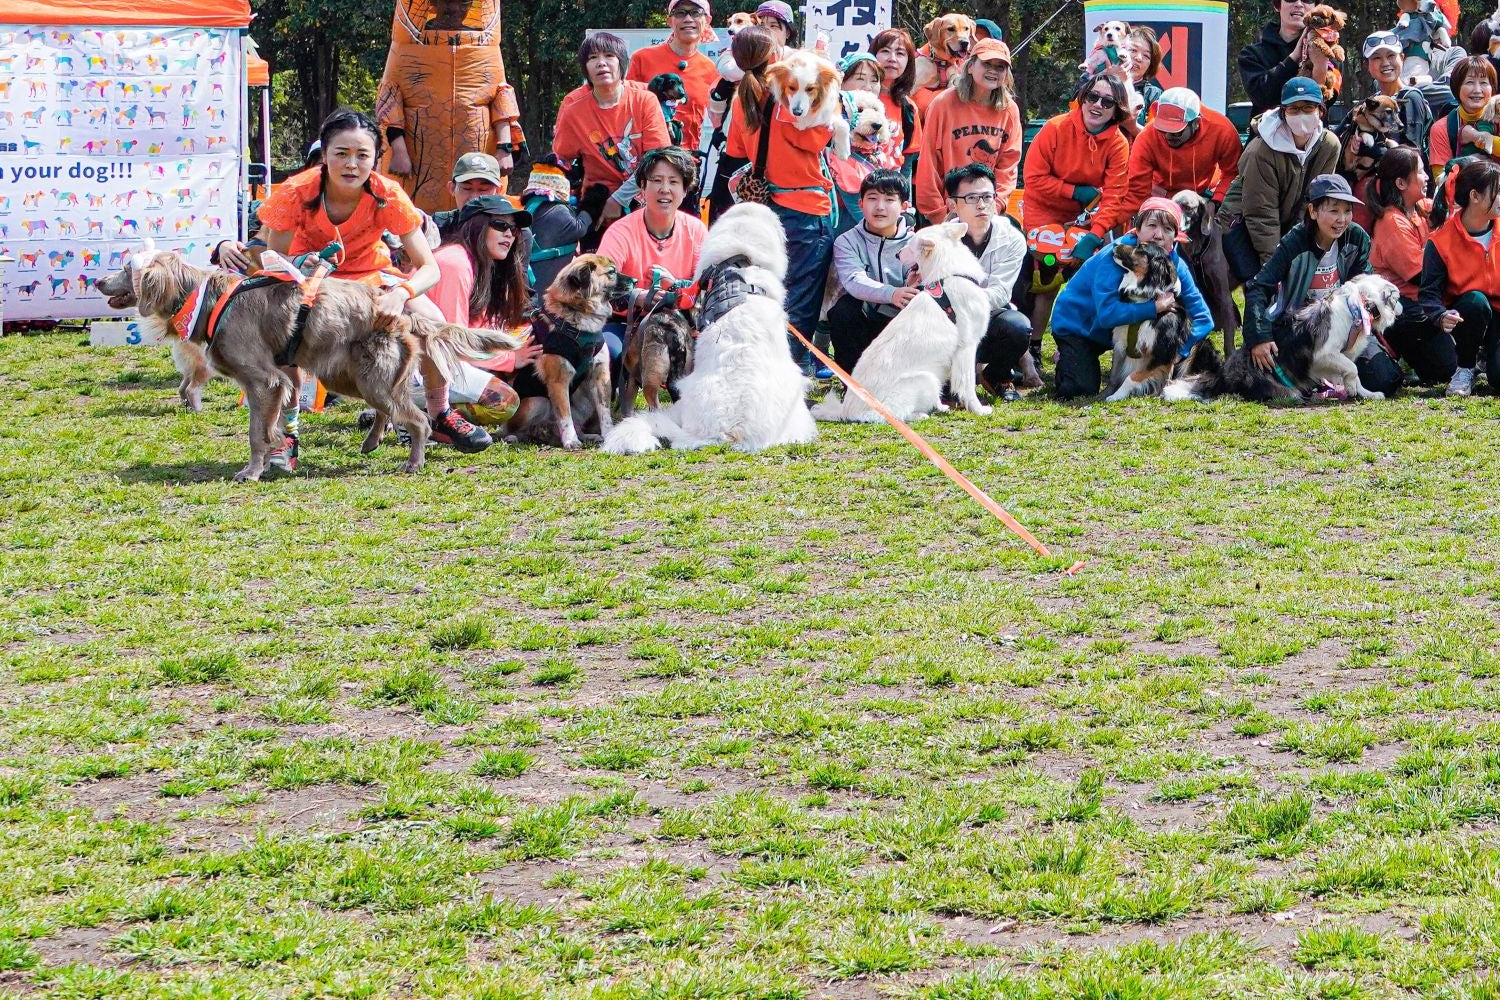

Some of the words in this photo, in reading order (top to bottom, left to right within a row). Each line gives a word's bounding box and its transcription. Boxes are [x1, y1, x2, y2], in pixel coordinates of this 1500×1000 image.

[10, 166, 63, 183] your
[68, 162, 133, 183] dog!!!
[126, 323, 142, 345] 3
